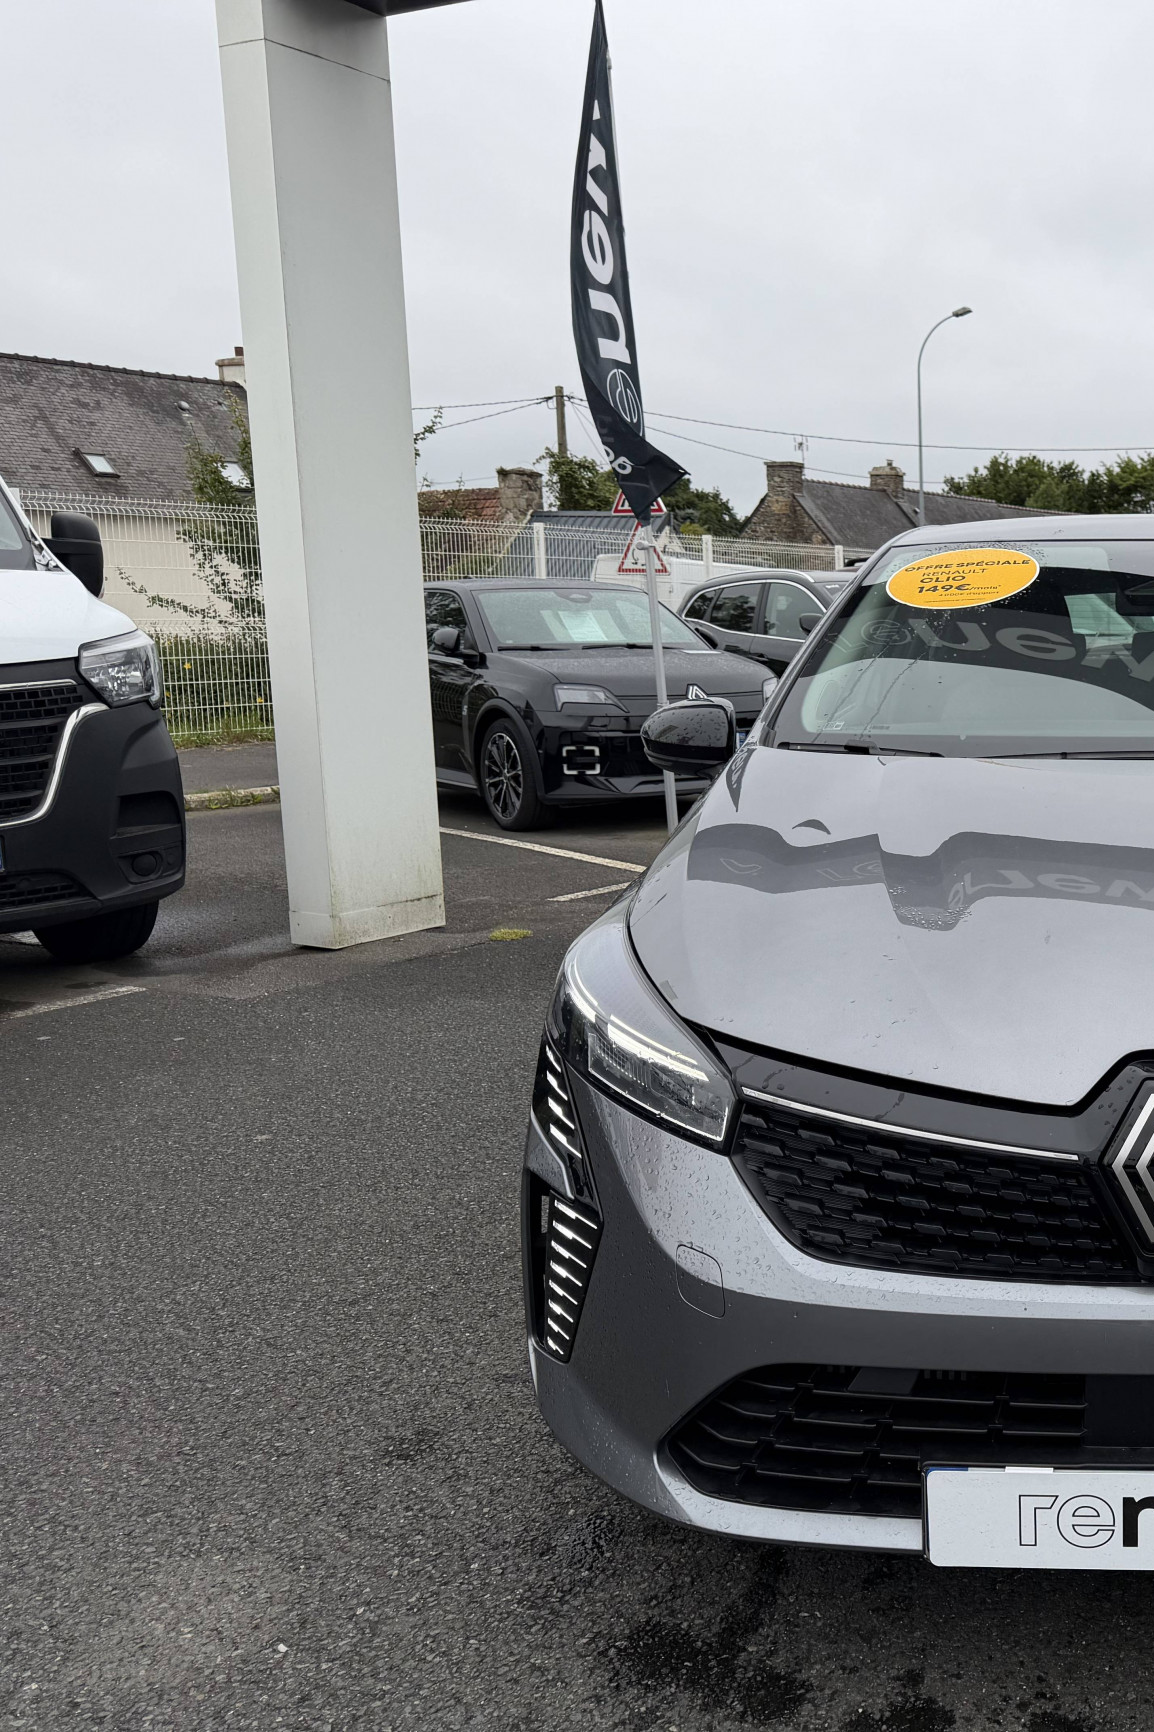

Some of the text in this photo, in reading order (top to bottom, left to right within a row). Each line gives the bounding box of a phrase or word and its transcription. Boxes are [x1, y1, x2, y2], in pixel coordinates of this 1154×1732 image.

[905, 559, 1031, 572] OFFRE SPÉCIALE
[922, 568, 988, 577] RENAULT
